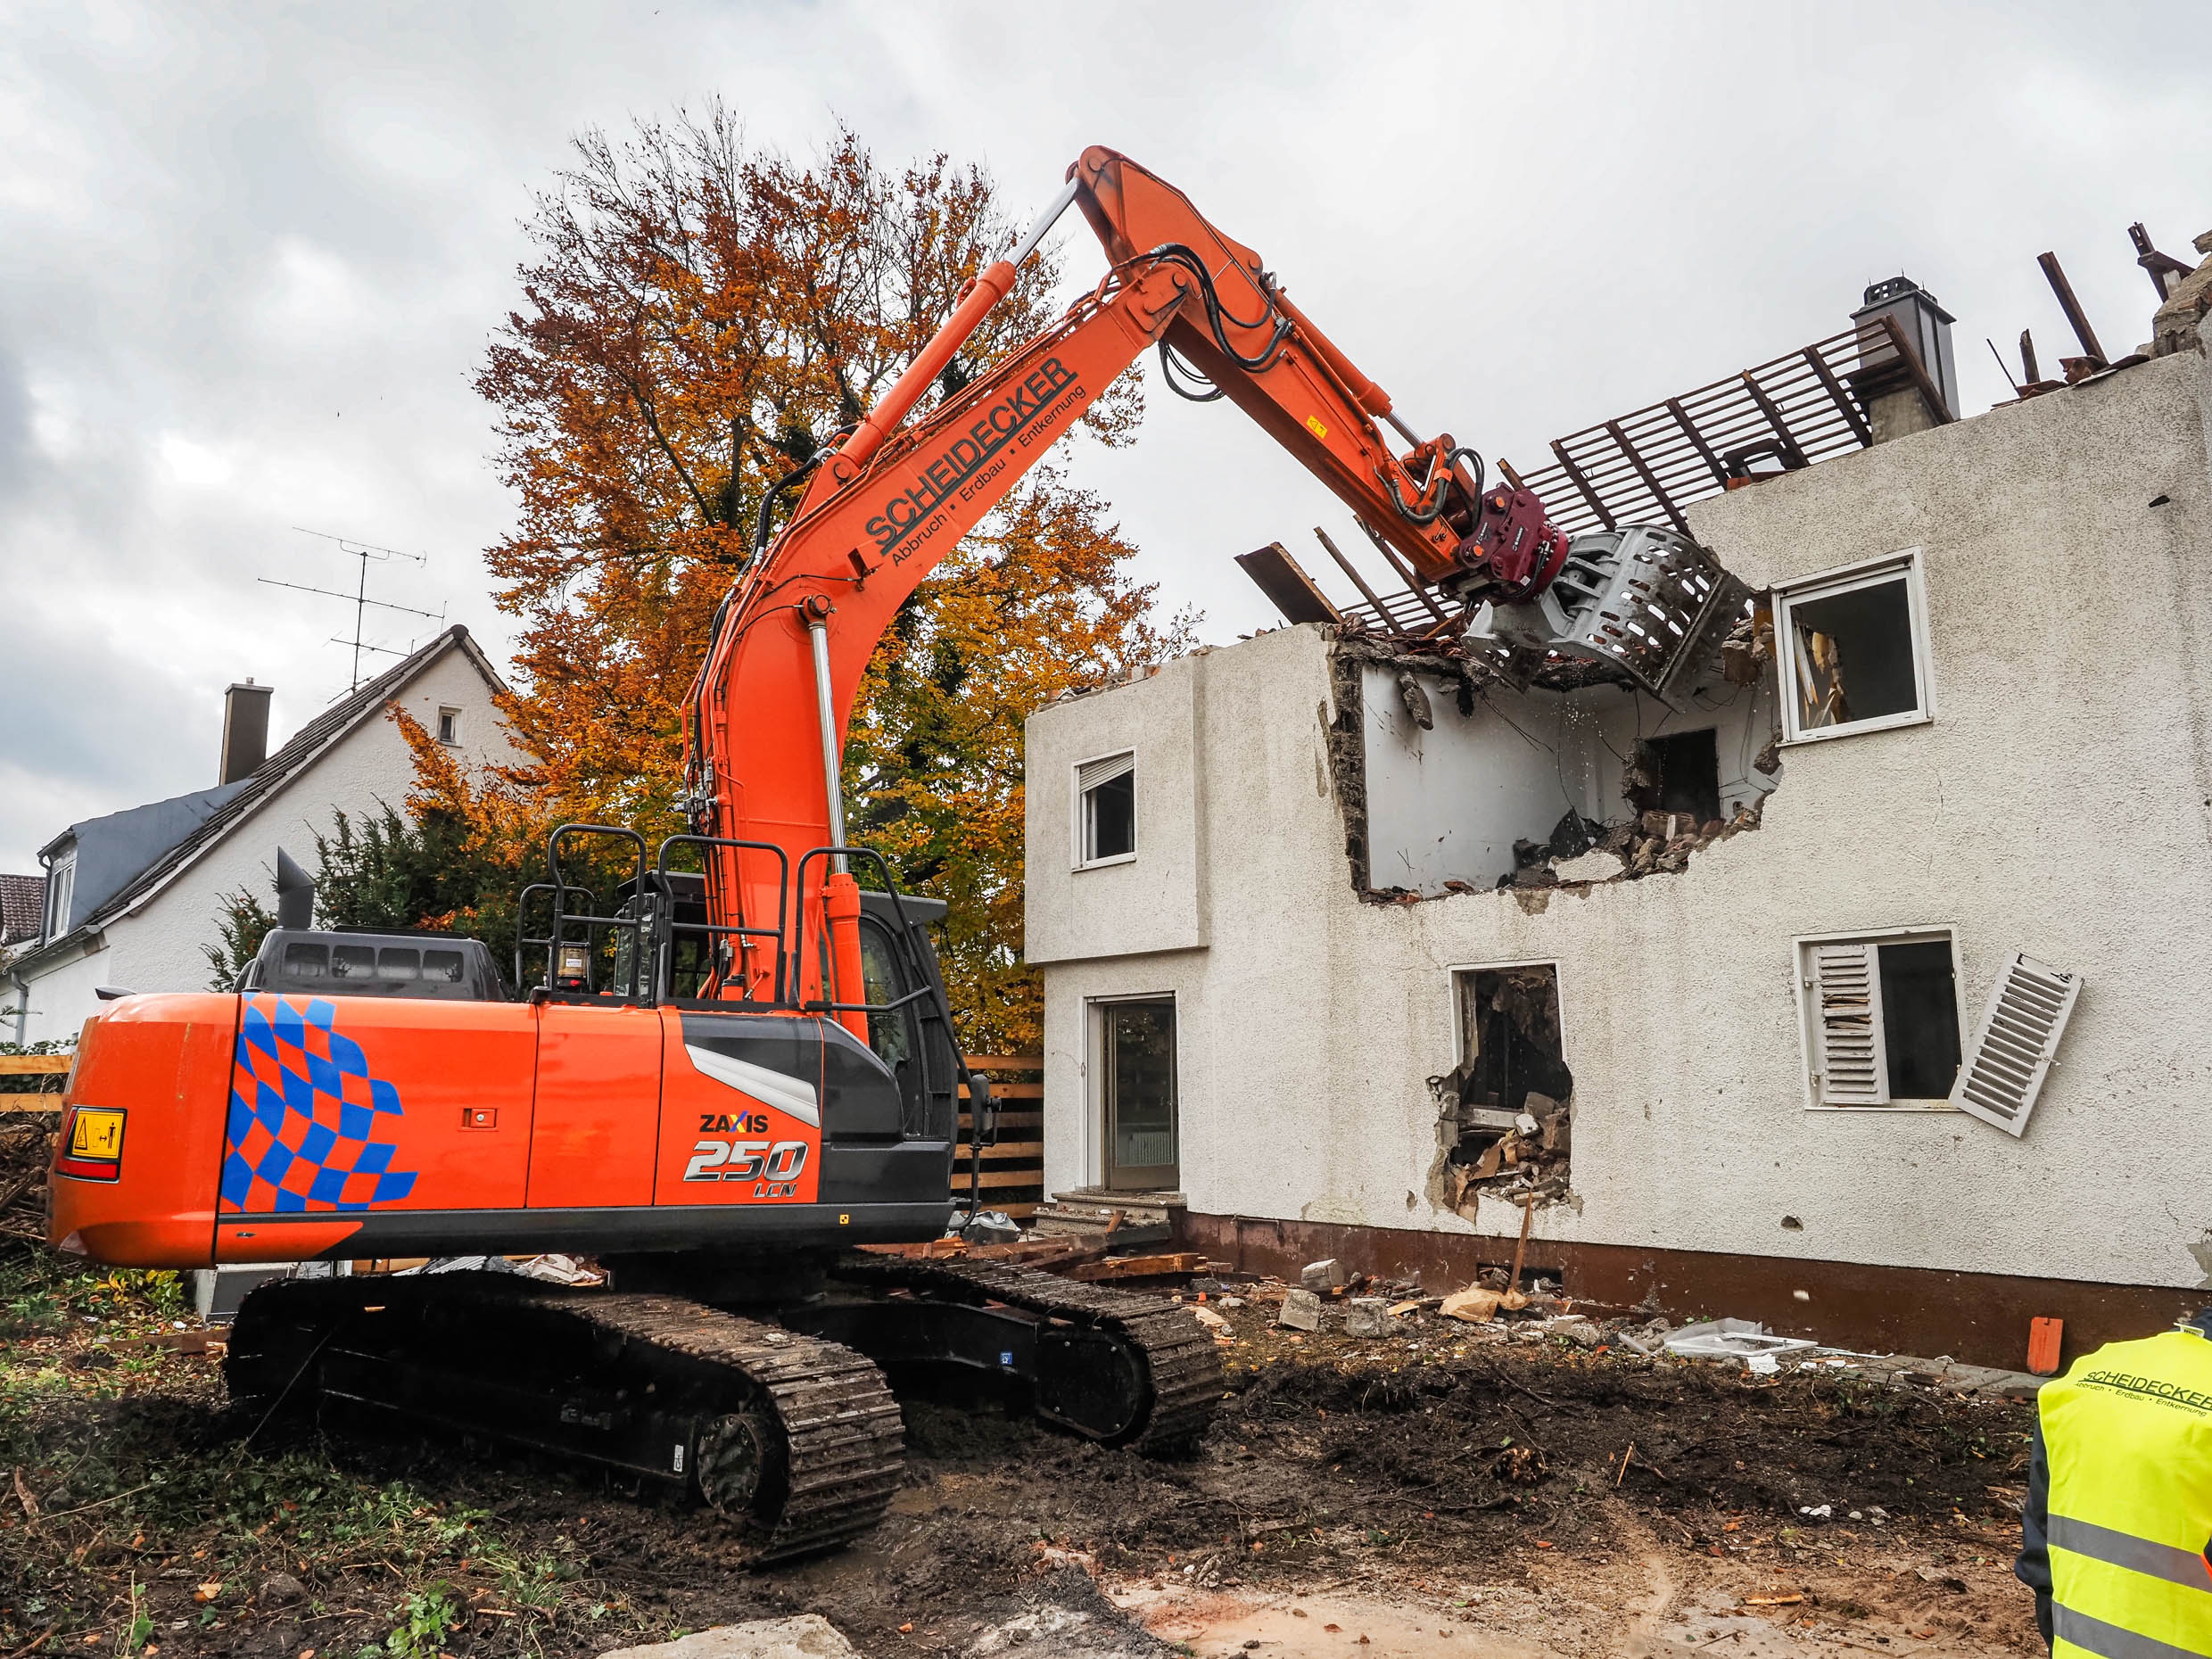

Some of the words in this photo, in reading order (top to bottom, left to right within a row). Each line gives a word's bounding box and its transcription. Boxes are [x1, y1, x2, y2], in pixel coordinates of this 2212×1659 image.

[865, 358, 1070, 546] SCHEIDECKER
[892, 513, 948, 566] Abbruch
[960, 459, 1006, 502] Erdbau
[1018, 384, 1086, 448] Entkernung
[699, 1110, 769, 1134] ZAXIS
[682, 1141, 809, 1182] 250
[753, 1183, 796, 1198] LCN
[2115, 1389, 2145, 1401] Erdbau
[2155, 1398, 2208, 1417] Entkernung
